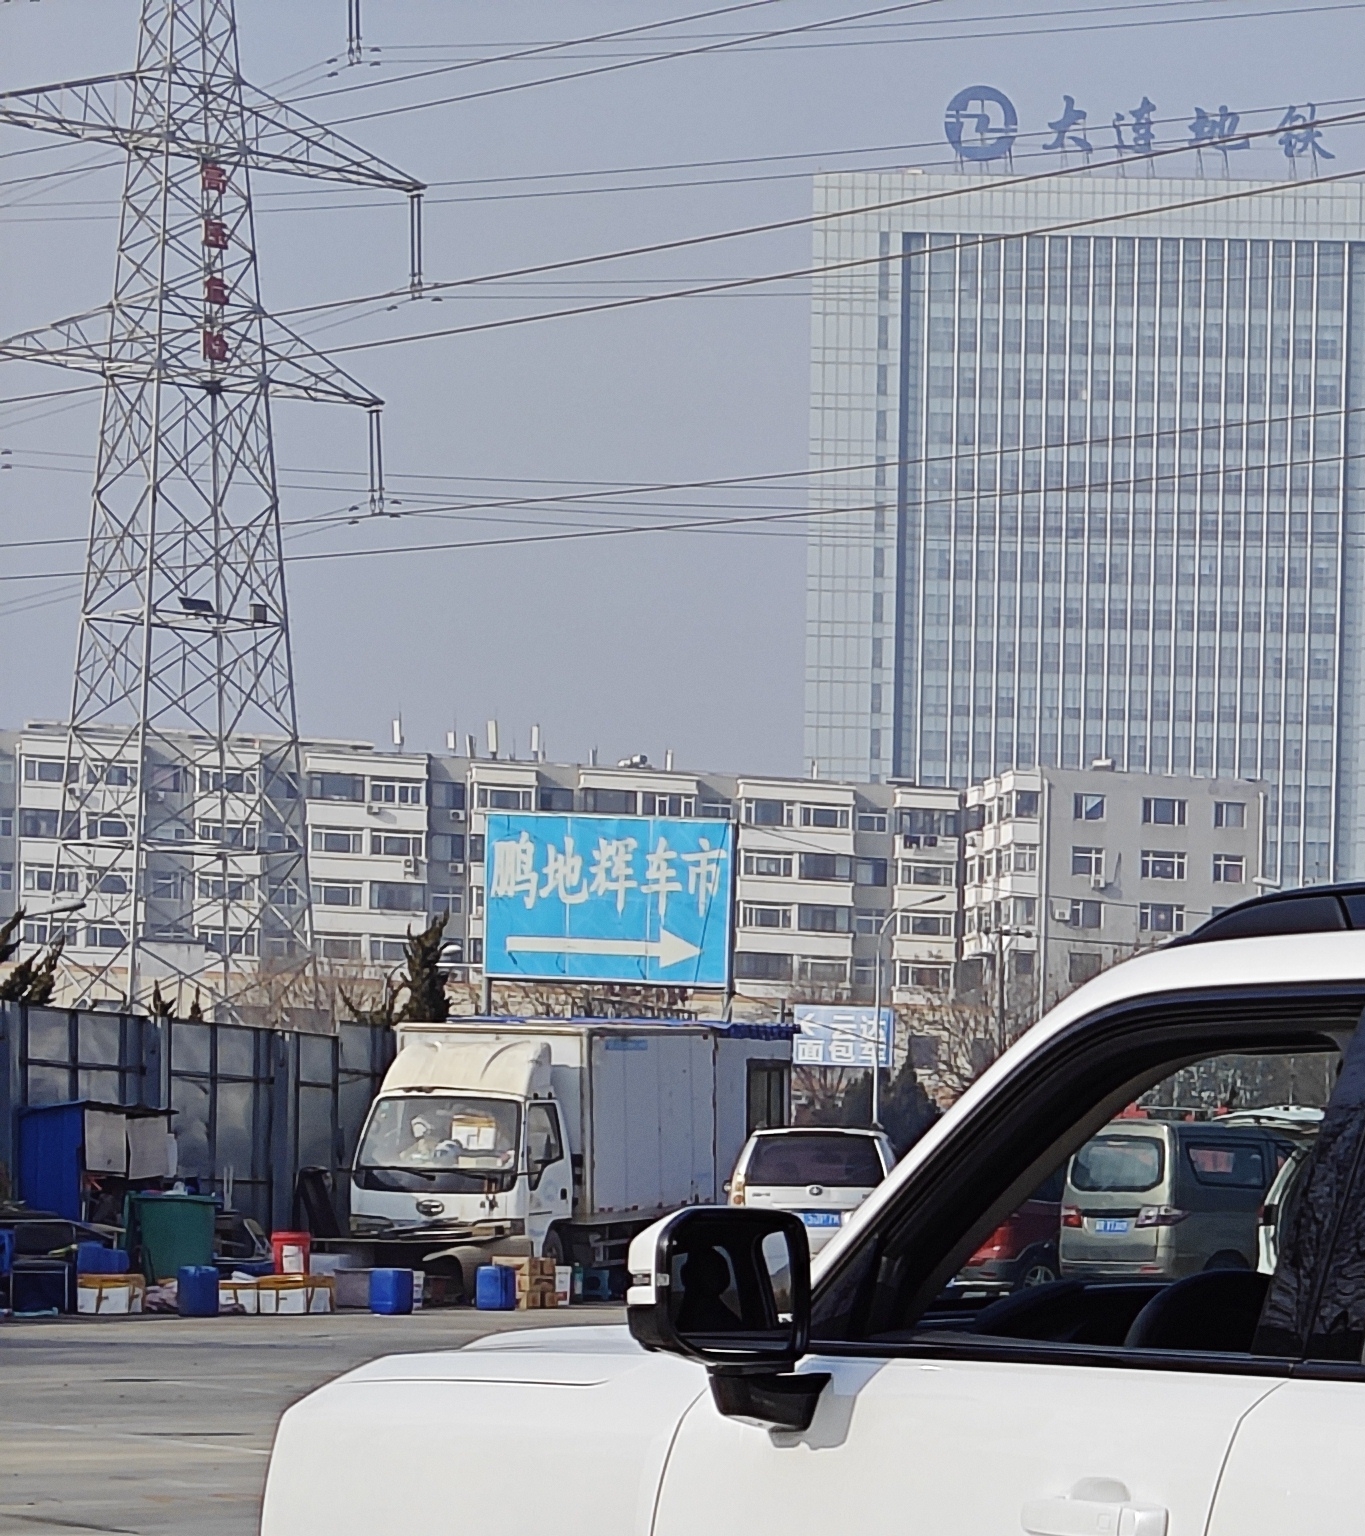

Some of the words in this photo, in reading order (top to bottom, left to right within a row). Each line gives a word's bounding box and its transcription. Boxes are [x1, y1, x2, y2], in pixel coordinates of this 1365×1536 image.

[1042, 95, 1335, 159] 大连地铁
[491, 831, 727, 919] 鹏地辉车市
[797, 1040, 887, 1063] 面包车
